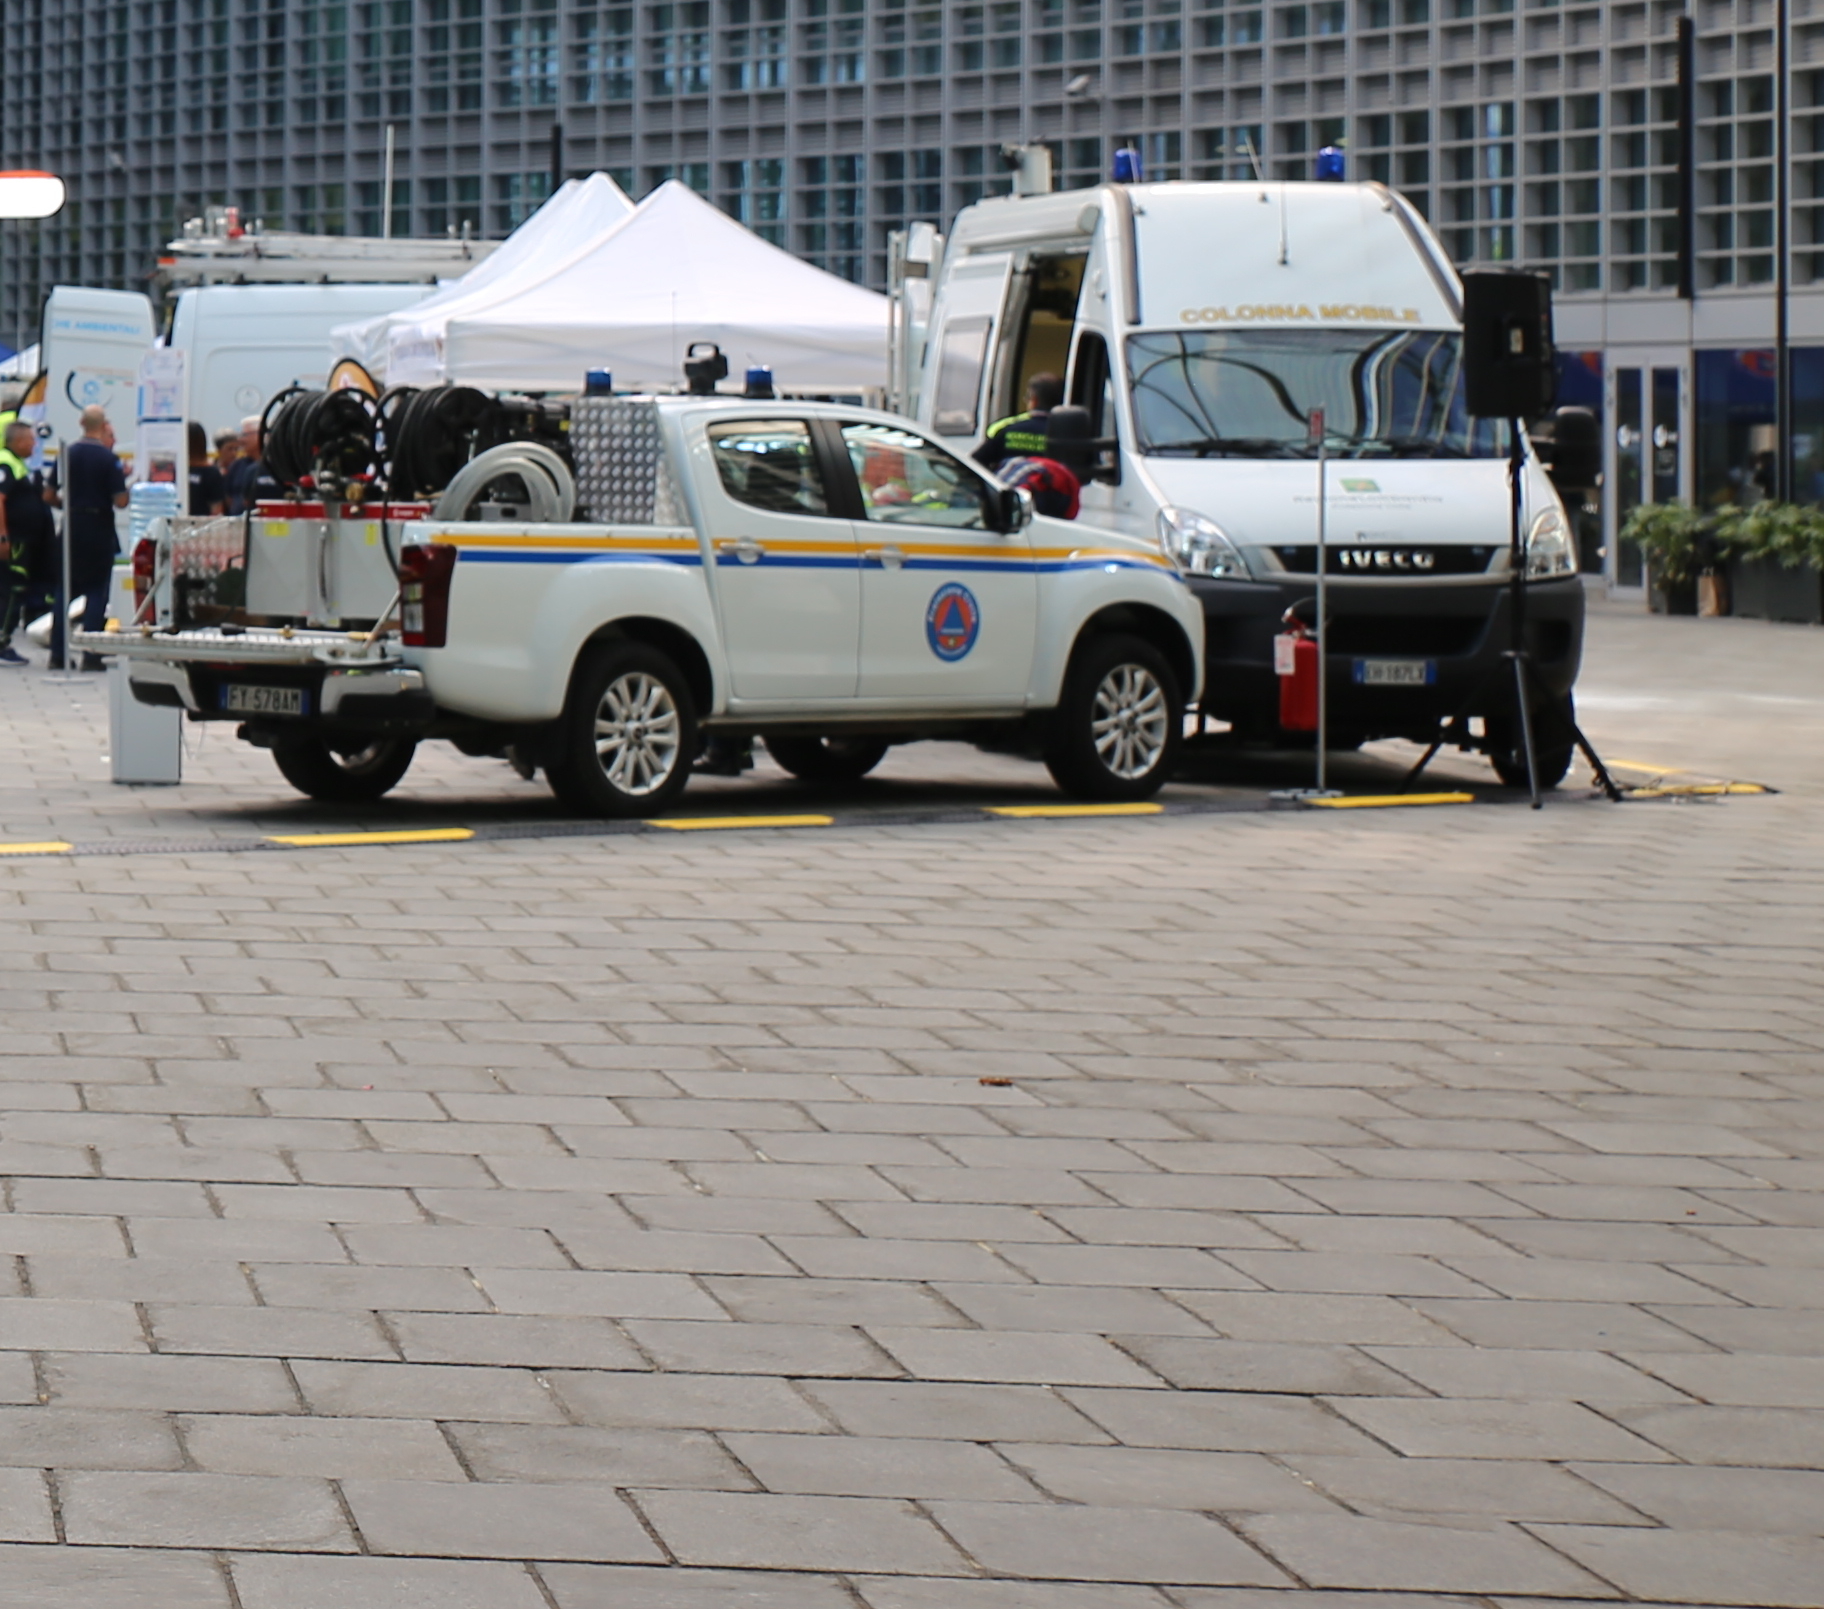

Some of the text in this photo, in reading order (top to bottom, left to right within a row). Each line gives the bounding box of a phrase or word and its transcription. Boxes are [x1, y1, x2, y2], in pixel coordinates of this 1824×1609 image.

[1180, 305, 1421, 324] COLONNA MOBILE
[1339, 549, 1435, 570] IVECO
[253, 687, 300, 713] 578AM
